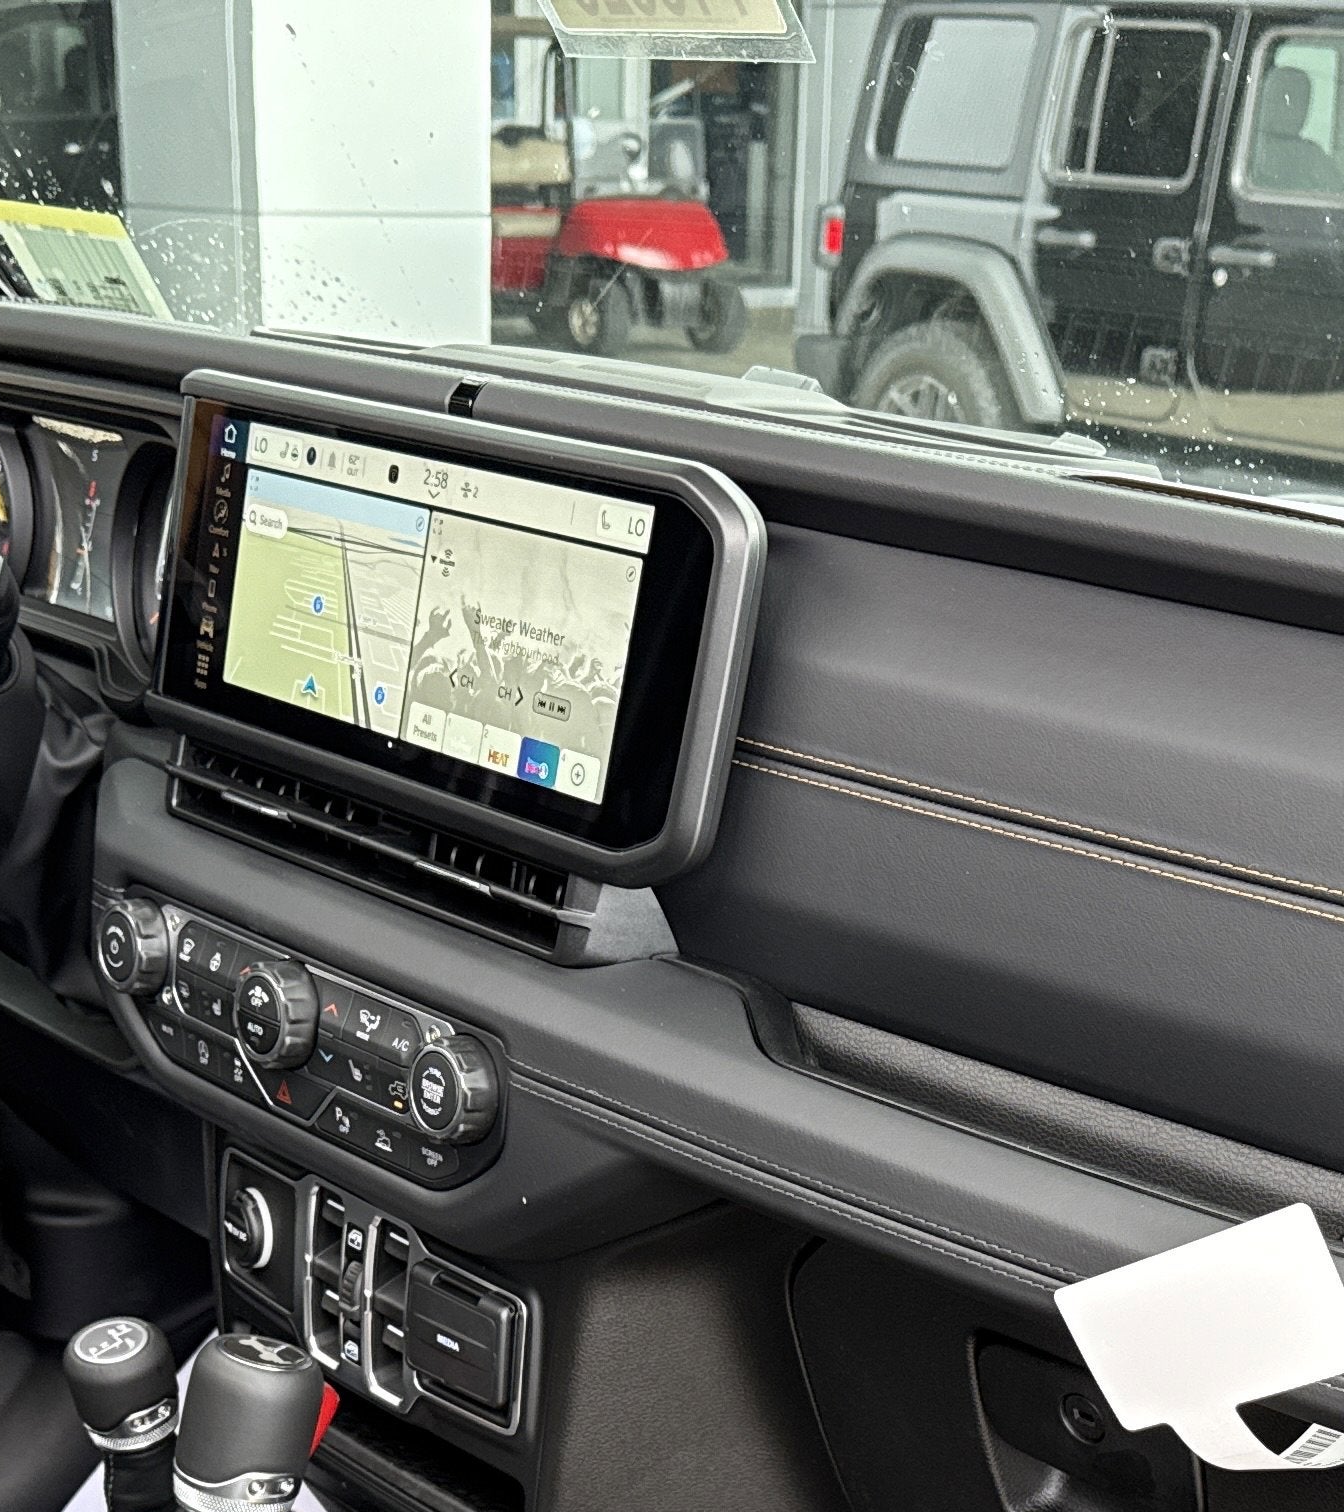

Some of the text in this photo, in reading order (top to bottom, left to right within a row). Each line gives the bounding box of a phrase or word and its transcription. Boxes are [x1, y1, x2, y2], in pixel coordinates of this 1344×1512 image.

[254, 436, 269, 454] LO
[423, 468, 449, 489] 2:58
[259, 514, 283, 530] Search
[627, 516, 646, 537] LO
[474, 607, 566, 647] Sweater Weather
[491, 637, 560, 665] Neighbourhood
[460, 674, 474, 689] CH
[498, 685, 512, 701] CH
[422, 713, 432, 725] All
[413, 726, 438, 743] Presets
[488, 748, 510, 768] HEAT
[247, 1021, 264, 1036] AUTO
[391, 1037, 410, 1053] A/C
[421, 1146, 444, 1163] SCREEN
